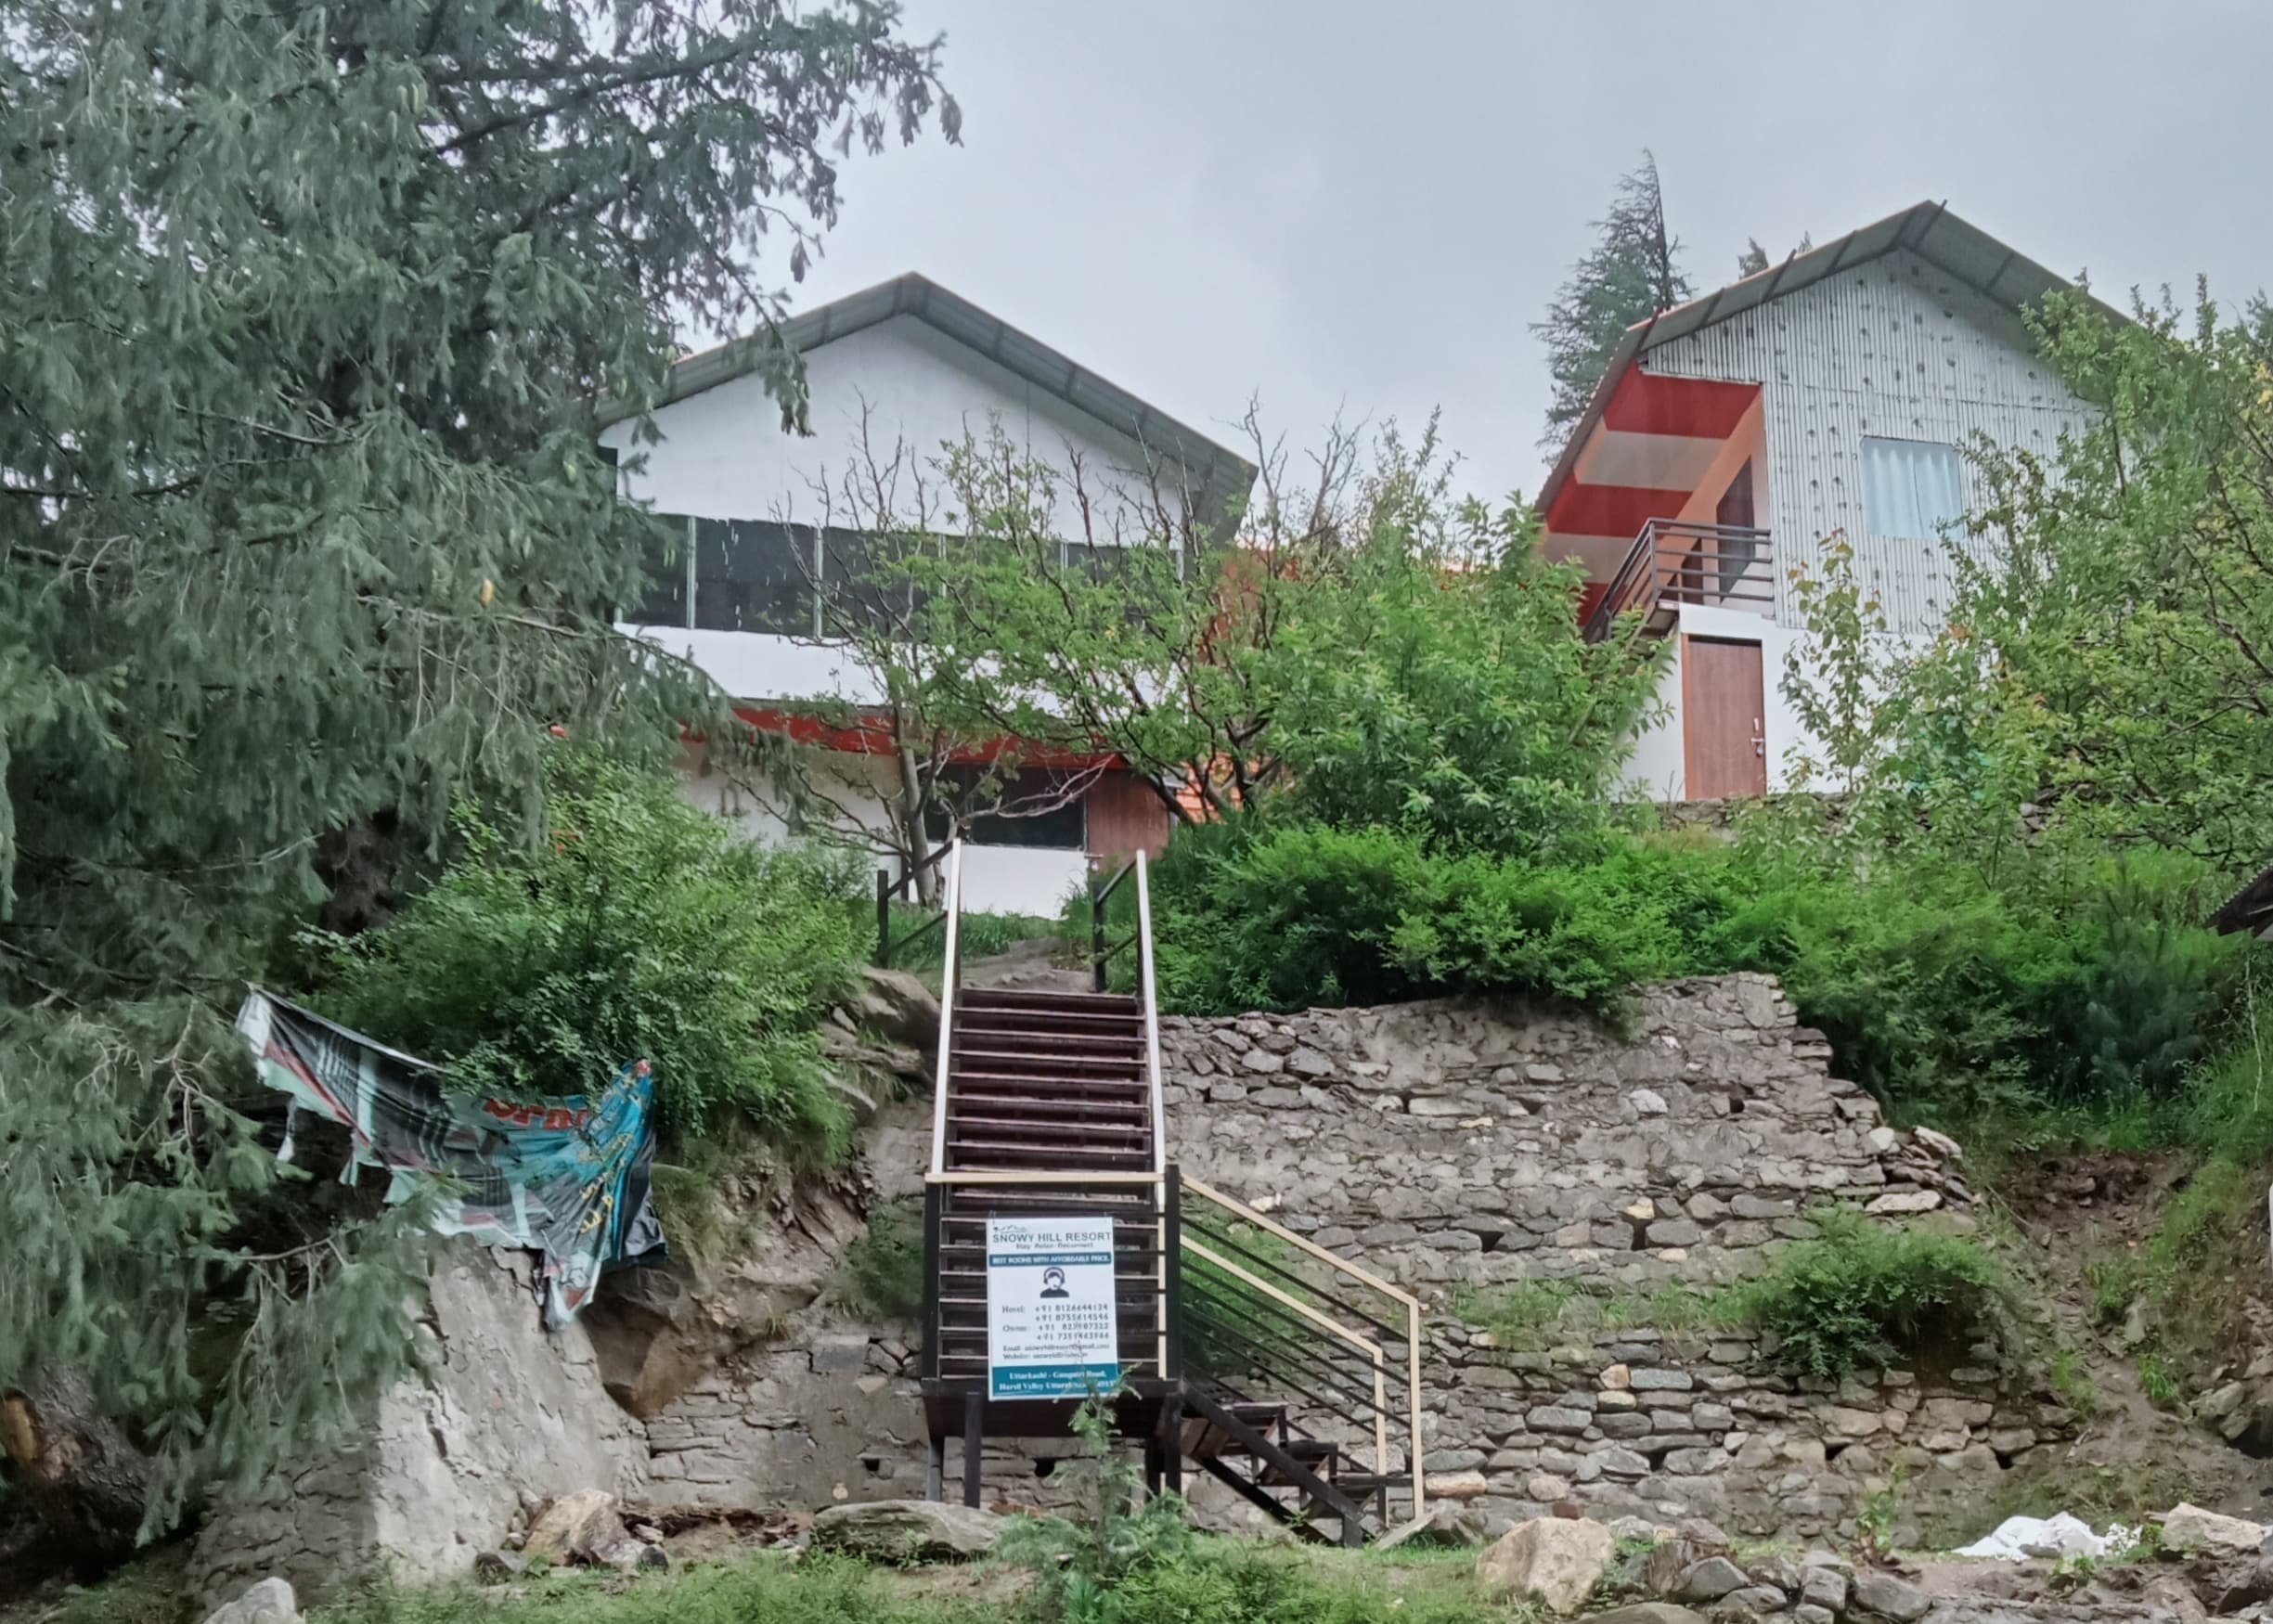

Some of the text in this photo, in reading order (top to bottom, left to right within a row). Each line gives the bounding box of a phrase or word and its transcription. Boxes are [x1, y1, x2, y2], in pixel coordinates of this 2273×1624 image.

[993, 1231, 1111, 1244] SNOWY HILL RESORT
[1033, 1256, 1050, 1264] WITH
[1051, 1255, 1090, 1263] AFFORDABLE
